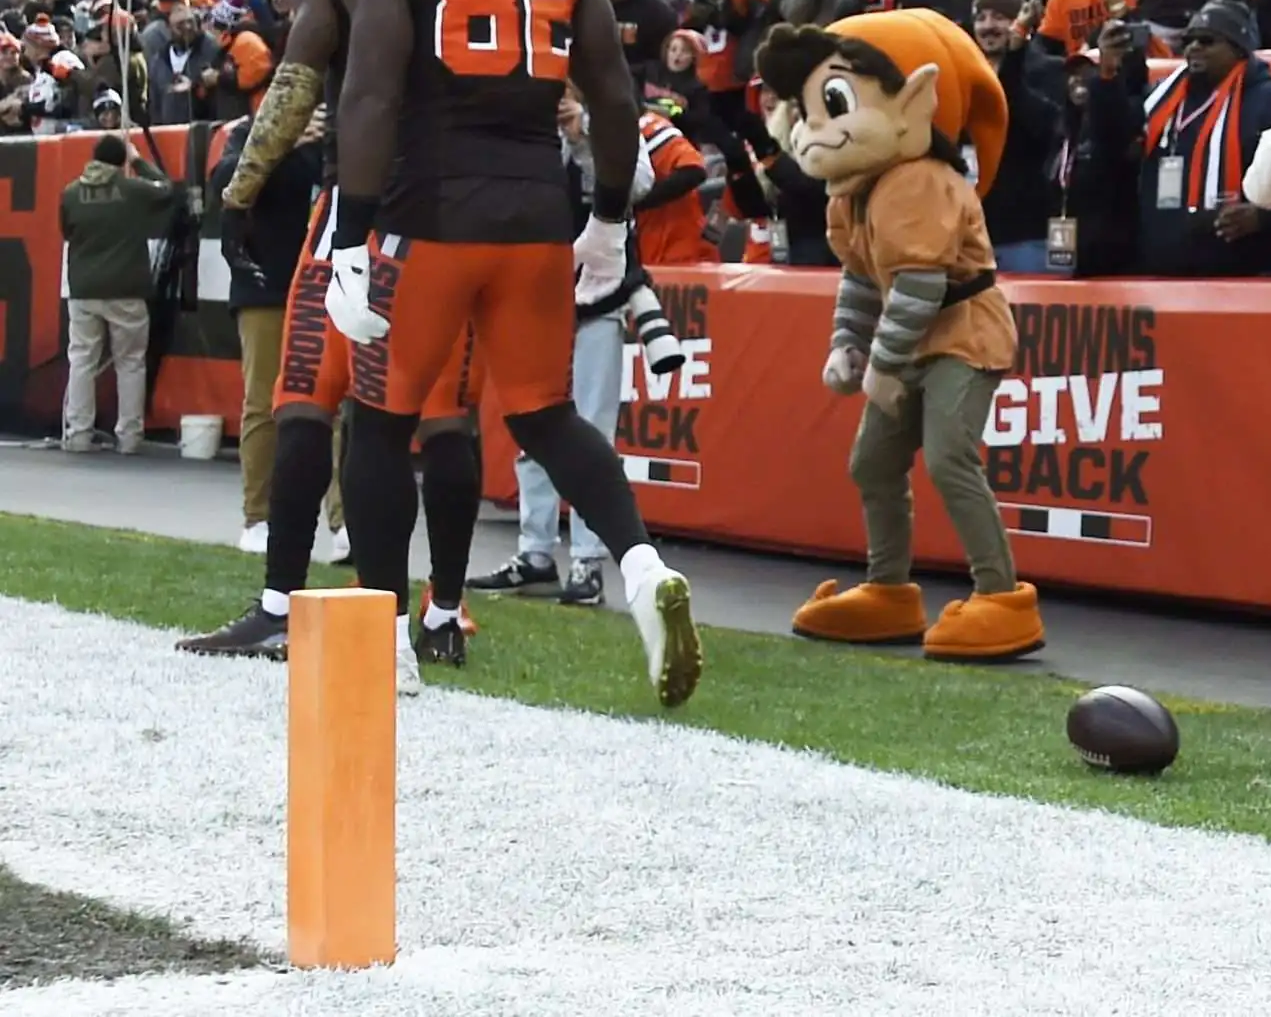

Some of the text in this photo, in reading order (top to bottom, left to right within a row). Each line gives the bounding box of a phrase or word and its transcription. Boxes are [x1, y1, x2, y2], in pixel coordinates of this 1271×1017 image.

[283, 259, 335, 396] BROWNS
[1010, 302, 1156, 376] ROWNS
[620, 337, 713, 405] IVE
[613, 401, 701, 454] ACK
[981, 368, 1164, 447] GIVE
[986, 445, 1150, 505] BACK
